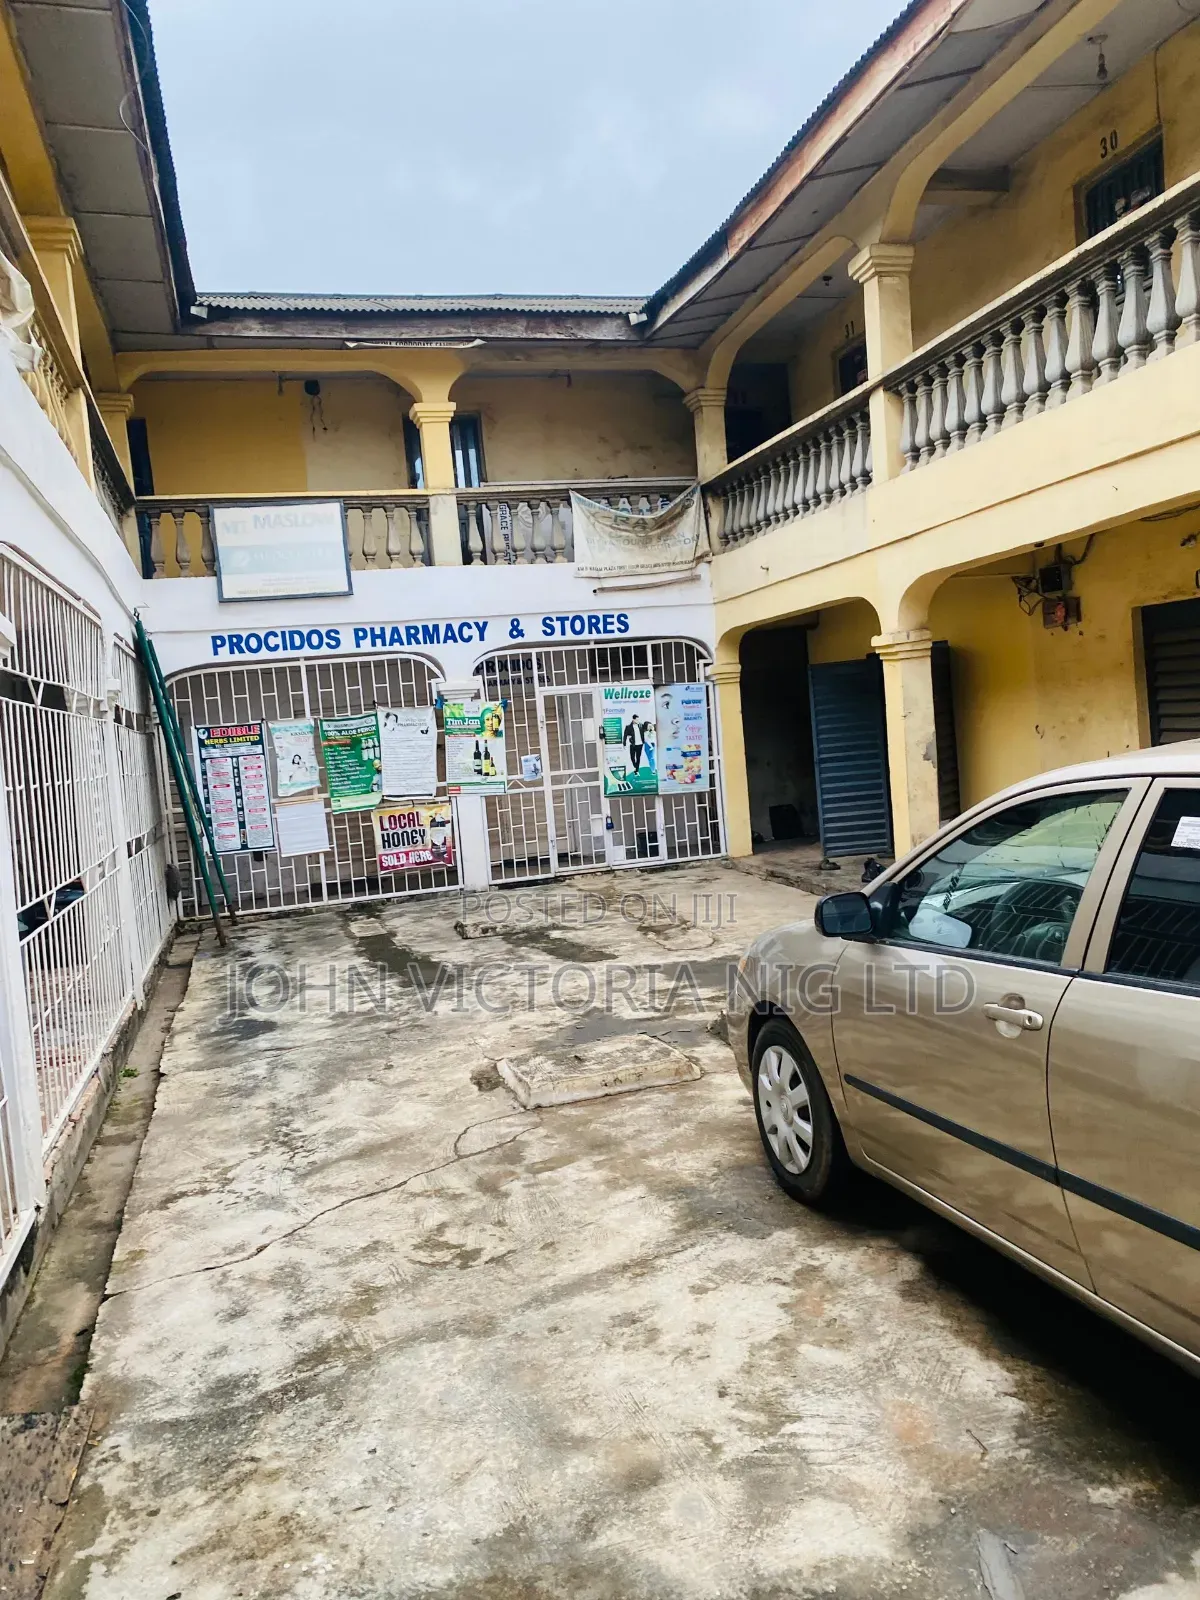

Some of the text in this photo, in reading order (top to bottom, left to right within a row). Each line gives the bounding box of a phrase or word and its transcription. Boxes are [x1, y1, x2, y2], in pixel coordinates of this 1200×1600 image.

[1100, 129, 1118, 159] 30
[844, 320, 855, 339] 31
[210, 613, 630, 656] PROCIDOS PHARMACY & STORES
[603, 686, 651, 700] Wellroze
[446, 717, 481, 726] Tim Jan
[204, 735, 260, 745] HERBS LIMITED
[210, 725, 261, 738] EDIBLE
[379, 811, 424, 832] LOCAL
[381, 829, 426, 849] HONEY
[381, 850, 433, 867] SOLD HERE
